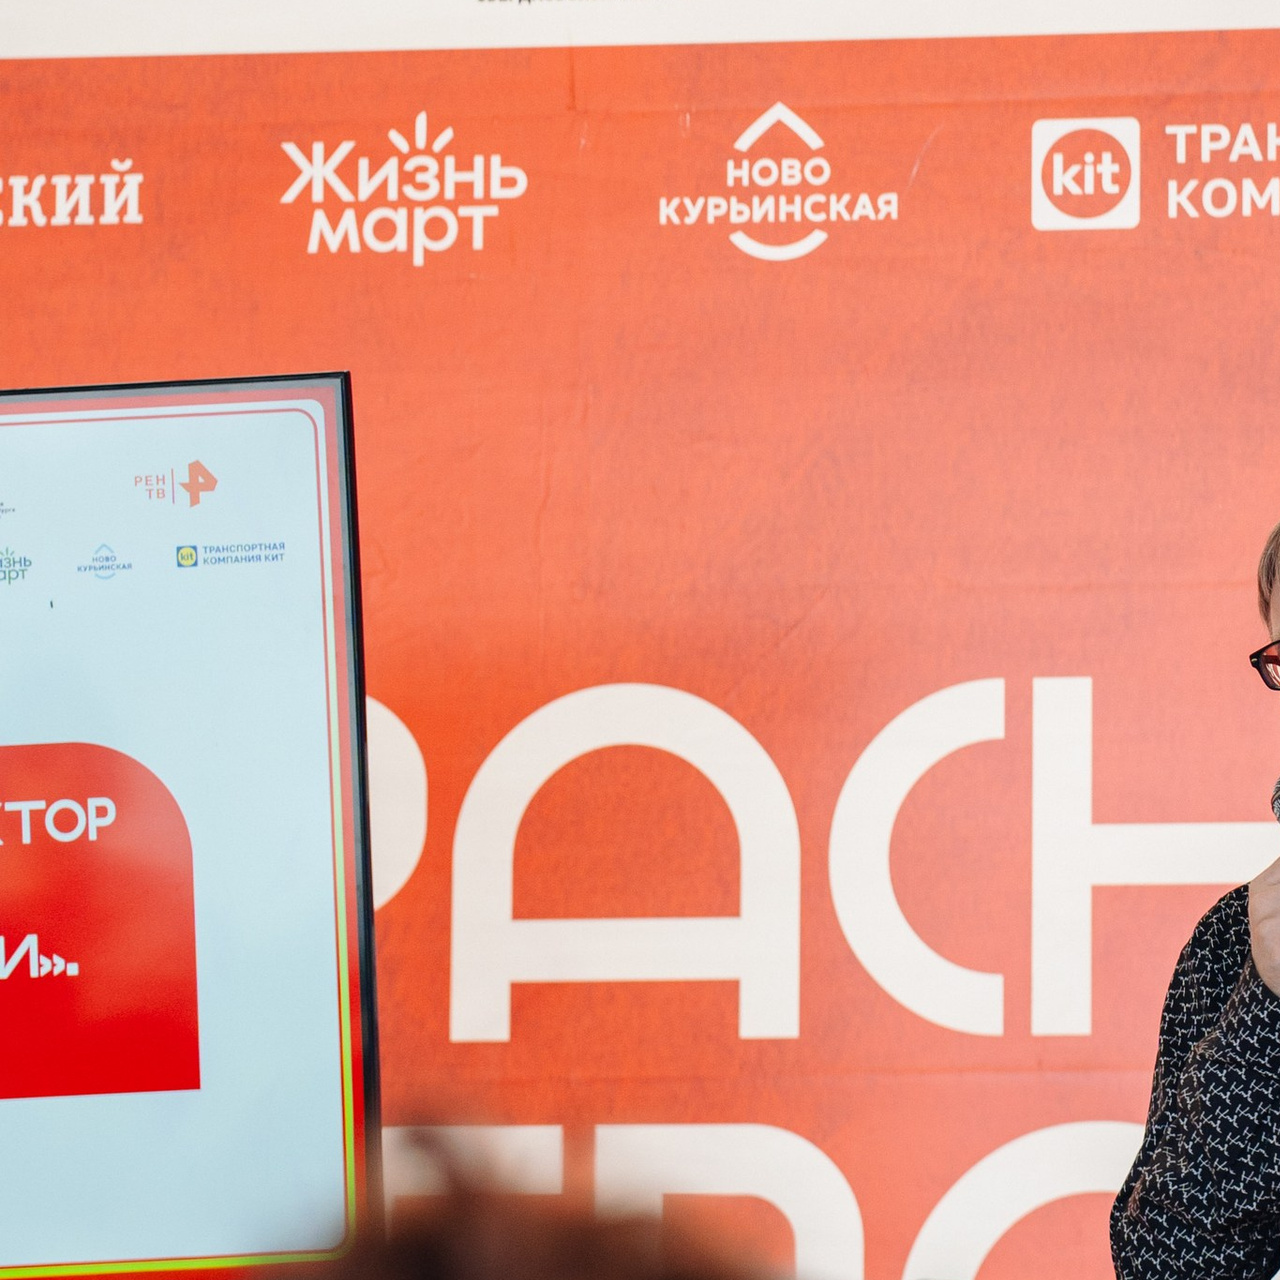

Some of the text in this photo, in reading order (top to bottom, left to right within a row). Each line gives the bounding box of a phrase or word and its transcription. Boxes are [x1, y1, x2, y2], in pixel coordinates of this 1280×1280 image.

[280, 140, 528, 204] Жизнь
[726, 157, 831, 187] НОВО
[1052, 152, 1120, 196] kit
[0, 158, 144, 228] кий
[659, 192, 899, 226] КУРЬИНСКАЯ
[307, 205, 499, 267] март
[134, 474, 166, 487] РЕН
[145, 488, 166, 500] ТВ
[92, 555, 117, 564] НОВО
[180, 552, 194, 562] kit
[202, 542, 286, 555] ТРАНСПОРТНАЯ
[203, 552, 286, 566] КОМПАНИЯ КИТ
[77, 563, 133, 573] КУРЬИНСКАЯ
[0, 796, 117, 845] ТОР
